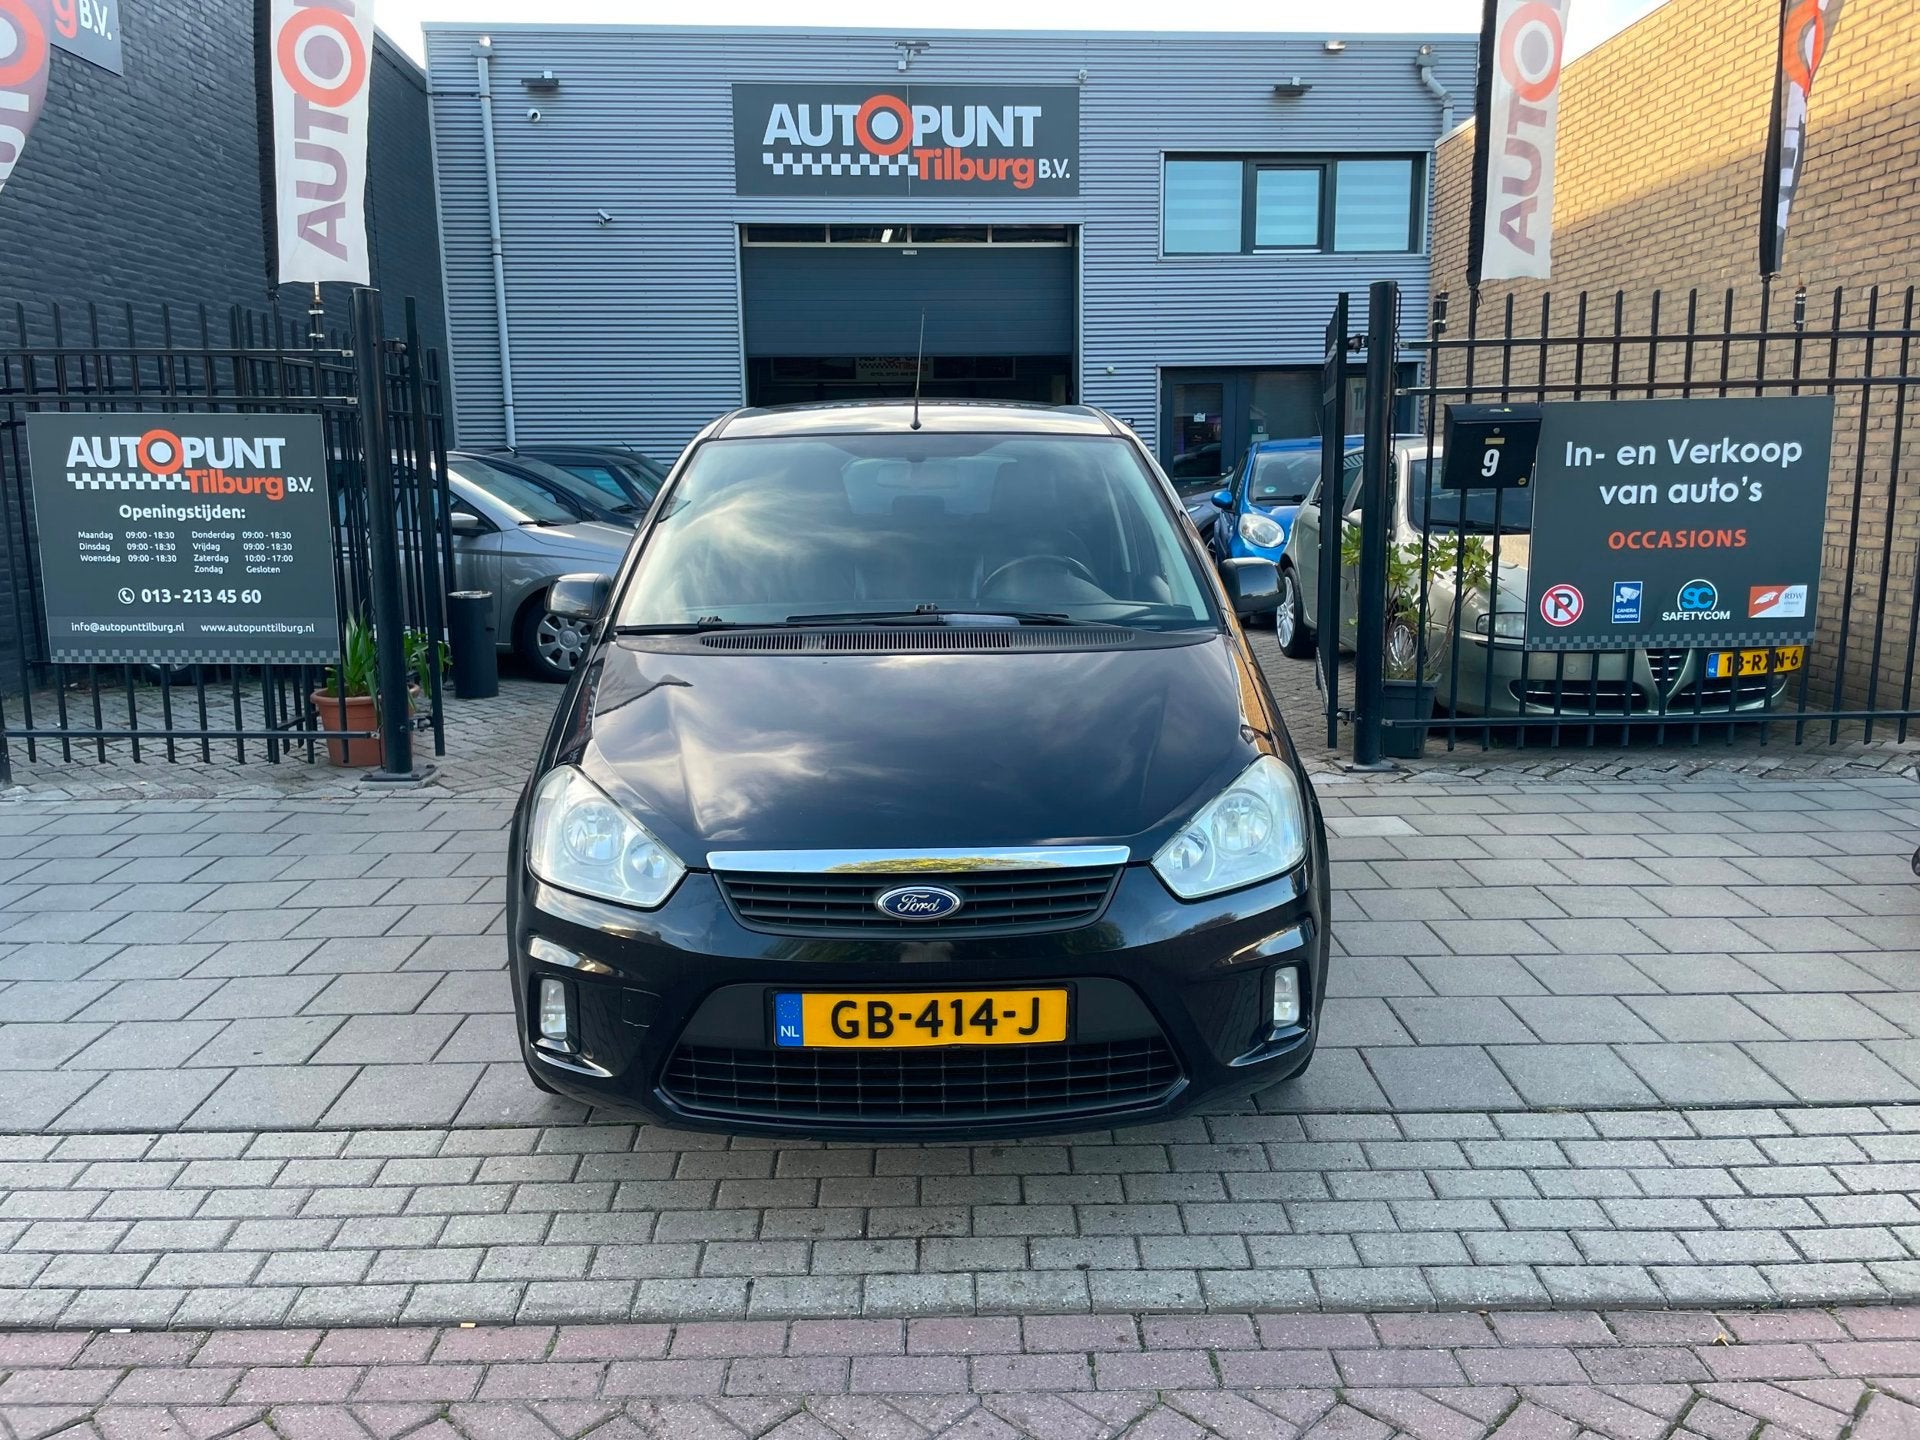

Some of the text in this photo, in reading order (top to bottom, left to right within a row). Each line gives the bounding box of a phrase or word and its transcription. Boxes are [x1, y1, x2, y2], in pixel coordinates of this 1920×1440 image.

[277, 0, 367, 262] AUTO
[762, 94, 1042, 156] AUTOPUNT
[913, 148, 1071, 189] Tilburg B.V.
[66, 429, 286, 475] AUTOPUNT
[1565, 437, 1803, 468] In- en Verkoop
[1481, 449, 1500, 477] 9
[185, 469, 314, 500] Tilburg B.V.
[1600, 476, 1763, 505] van auto’s
[119, 504, 246, 521] Openingstijden:
[78, 531, 114, 540] Maandag
[125, 531, 148, 539] 09:00
[153, 531, 175, 539] 18:30
[191, 531, 235, 540] Donderdag
[242, 531, 264, 539] 09:00
[270, 531, 292, 539] 18:30
[1607, 529, 1747, 550] OCCASIONS
[79, 542, 111, 552] Dinsdag
[126, 543, 149, 551] 09:00
[154, 543, 176, 551] 18:30
[192, 542, 221, 552] Vrijdag
[243, 543, 265, 551] 09:00
[271, 543, 293, 551] 18:30
[80, 554, 121, 564] Woensdag
[127, 554, 150, 562] 09:00
[155, 554, 177, 562] 18:30
[193, 554, 229, 564] Zaterdag
[244, 554, 266, 562] 10:00
[271, 554, 294, 562] 17:00
[194, 565, 281, 575] Zondag Gesloten
[217, 589, 237, 604] 45
[241, 589, 262, 604] 60
[1784, 592, 1804, 600] RDW
[1661, 610, 1731, 622] SAFETYCOM
[71, 621, 315, 635] info@autopunttilburg.nl www.autopunttilburg.nl
[897, 893, 941, 912] Ford
[831, 997, 1041, 1040] GB-414-J
[780, 1025, 800, 1038] NL
